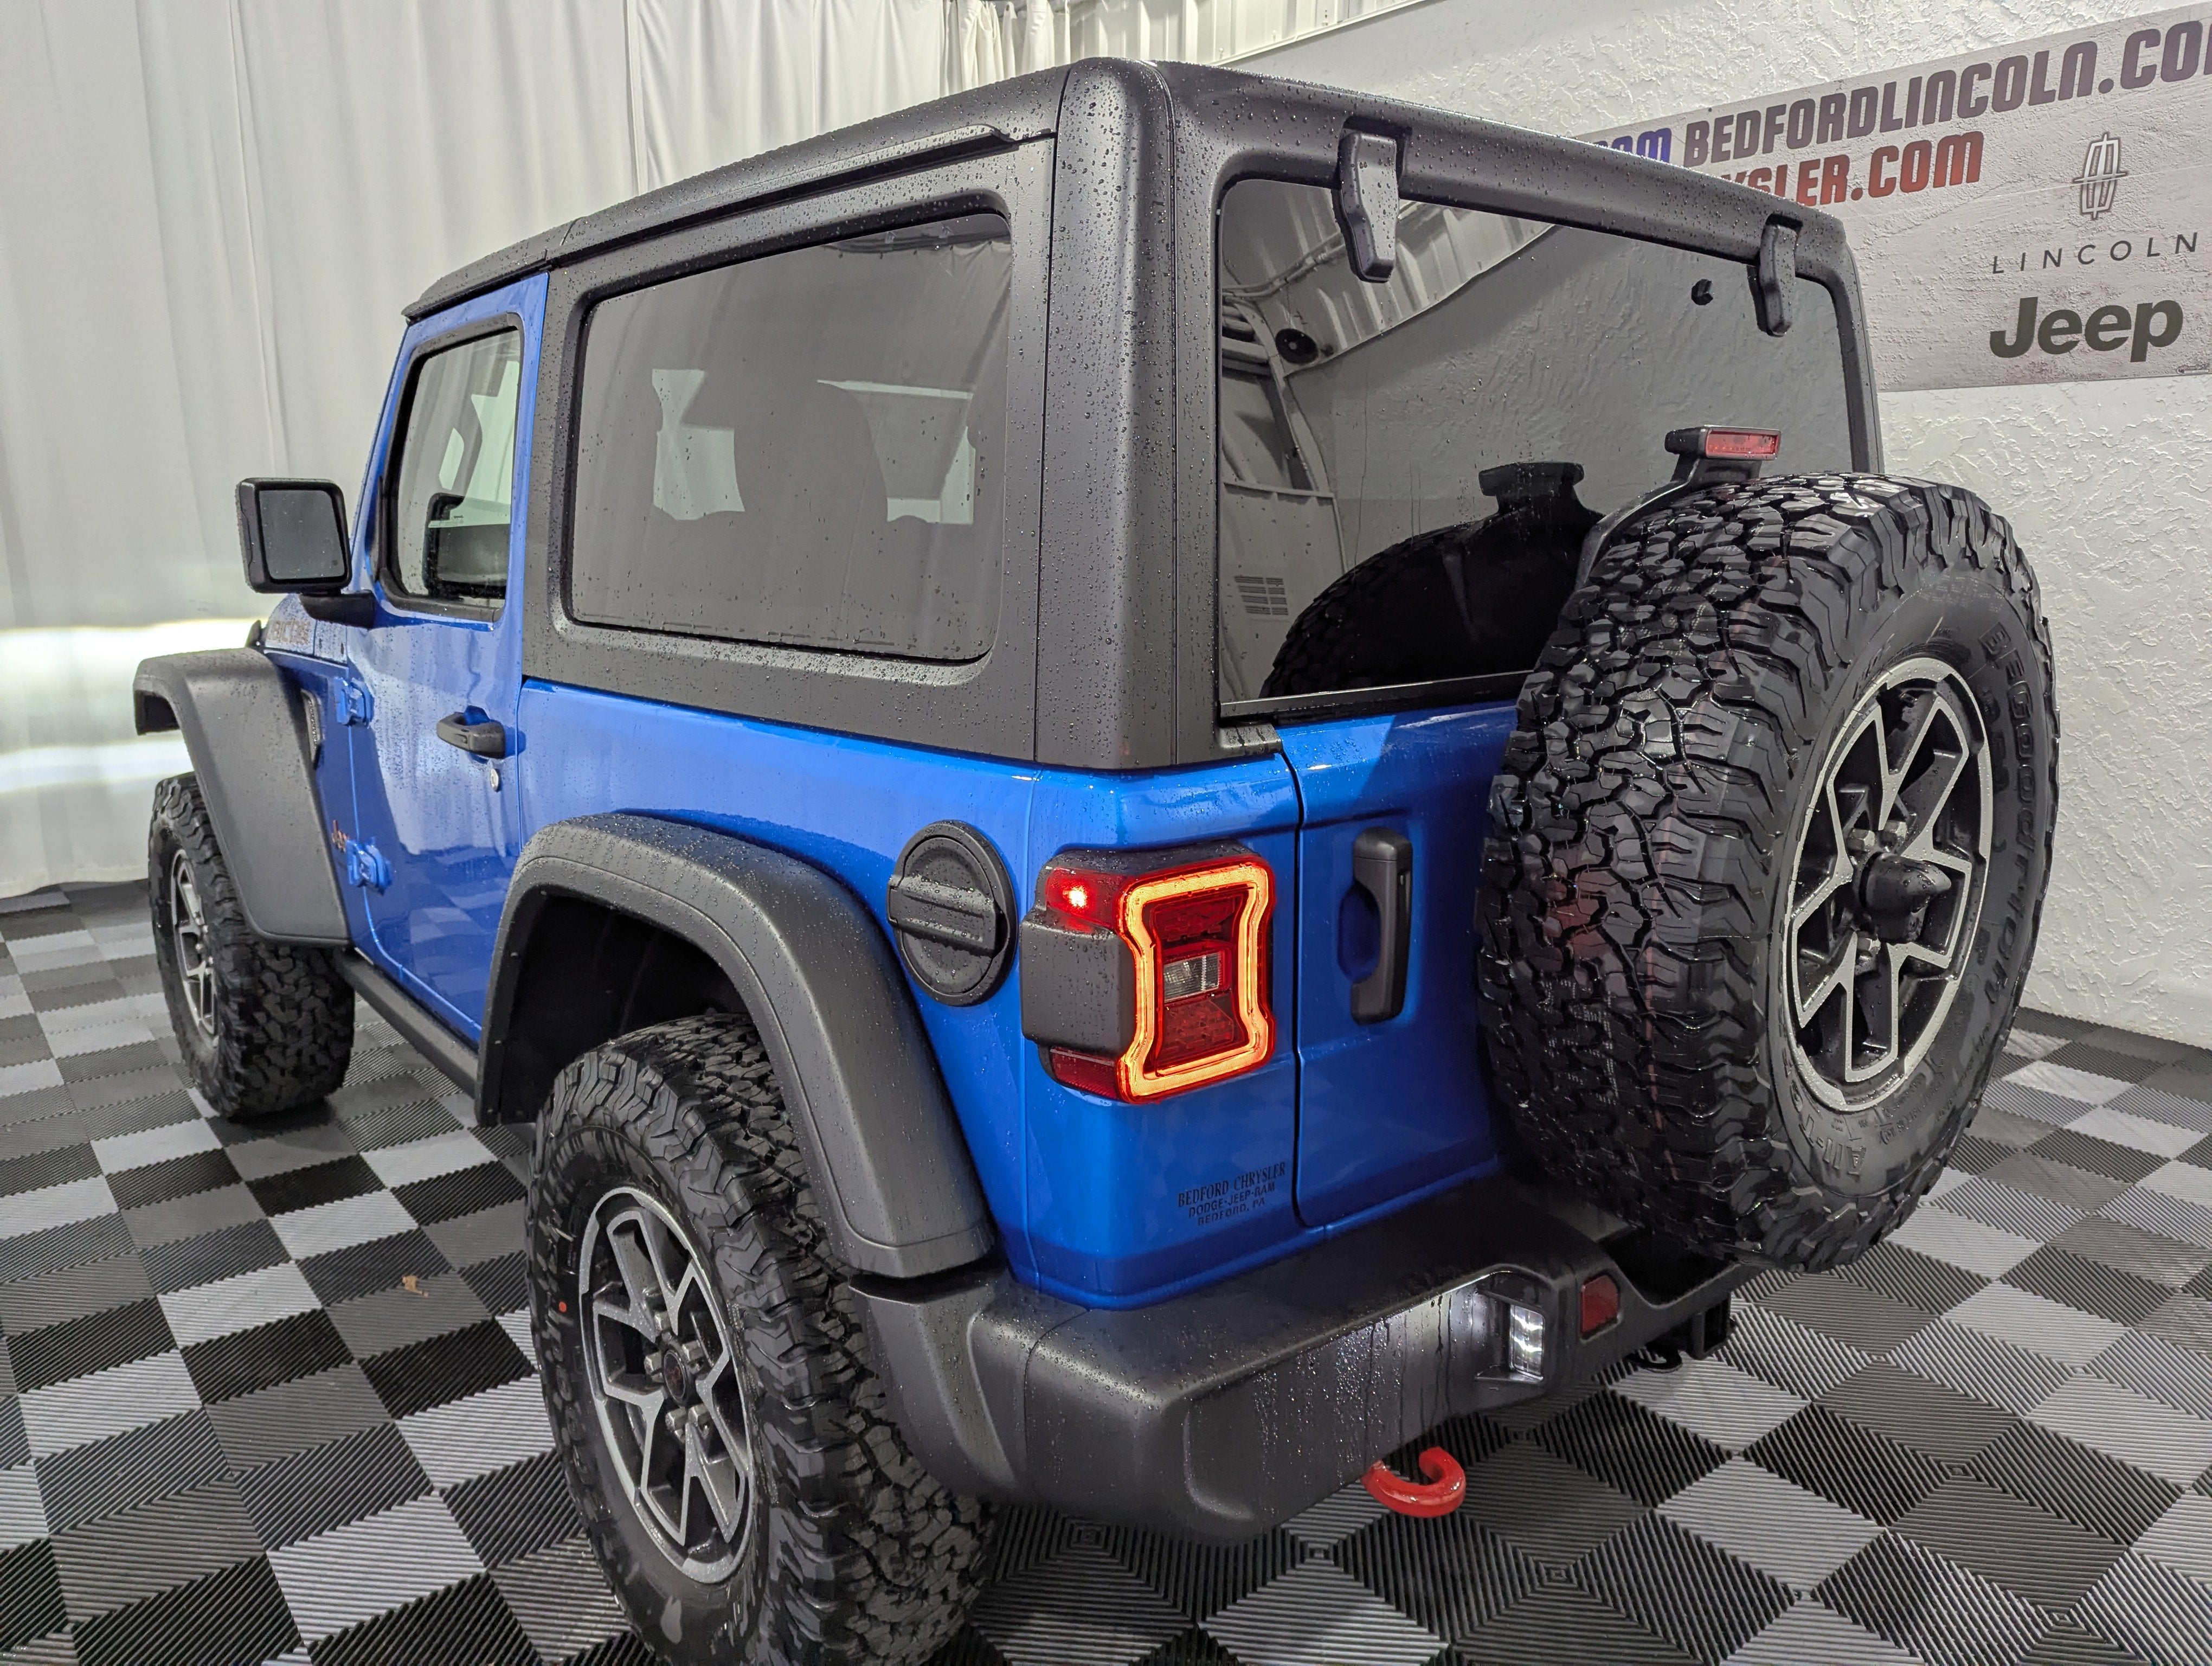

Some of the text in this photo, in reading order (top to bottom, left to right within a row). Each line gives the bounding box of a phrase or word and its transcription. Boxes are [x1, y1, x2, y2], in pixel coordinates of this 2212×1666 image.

[1683, 20, 2212, 166] BEDFORDLINCOLN.CO
[1992, 232, 2197, 274] LINCOLN
[1989, 296, 2184, 363] Jeep
[1178, 1162, 1286, 1207] BEDFORD CHRYSLER
[1252, 1196, 1265, 1208] PA
